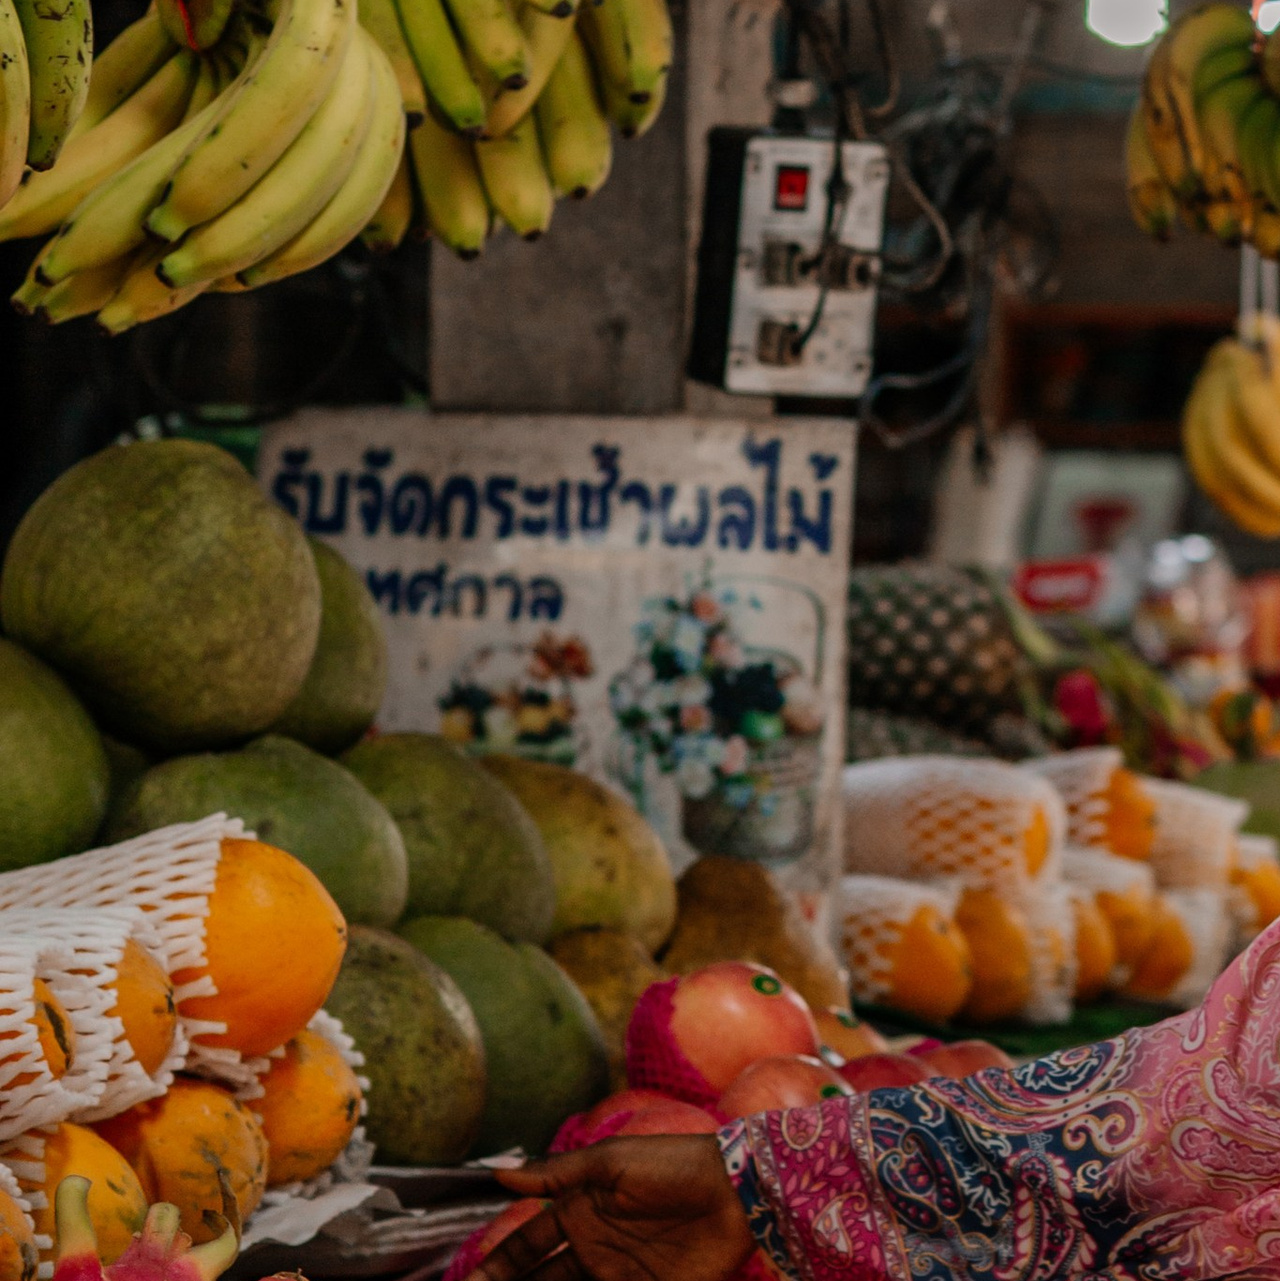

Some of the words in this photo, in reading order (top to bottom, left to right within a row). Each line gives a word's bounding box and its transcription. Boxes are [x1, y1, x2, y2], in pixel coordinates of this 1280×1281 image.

[272, 436, 838, 554] รับจัดกระเช้าผลไม้
[366, 562, 565, 621] ทศกาล
